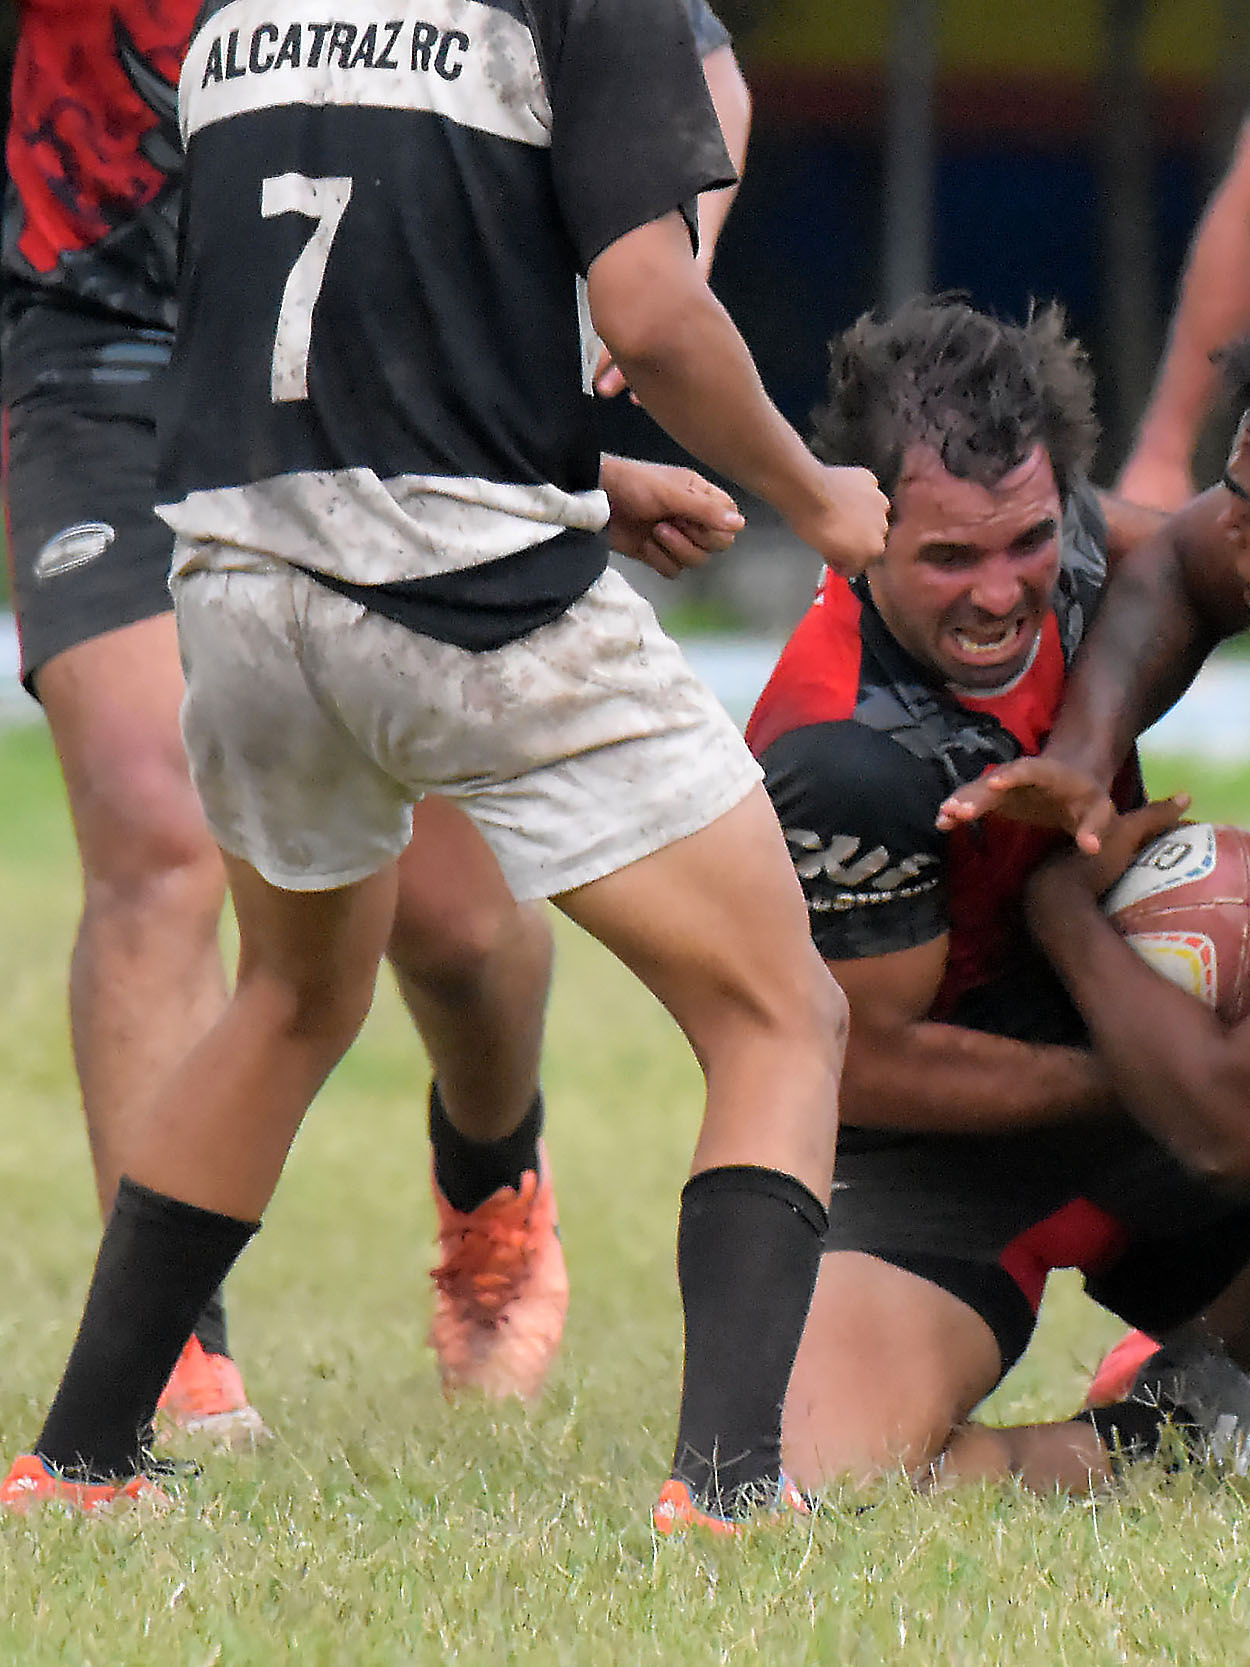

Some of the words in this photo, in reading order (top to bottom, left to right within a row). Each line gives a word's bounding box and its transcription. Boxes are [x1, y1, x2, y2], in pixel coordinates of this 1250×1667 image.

[201, 19, 403, 89] ALCATRAZ
[411, 20, 470, 81] RC
[261, 172, 353, 403] 7
